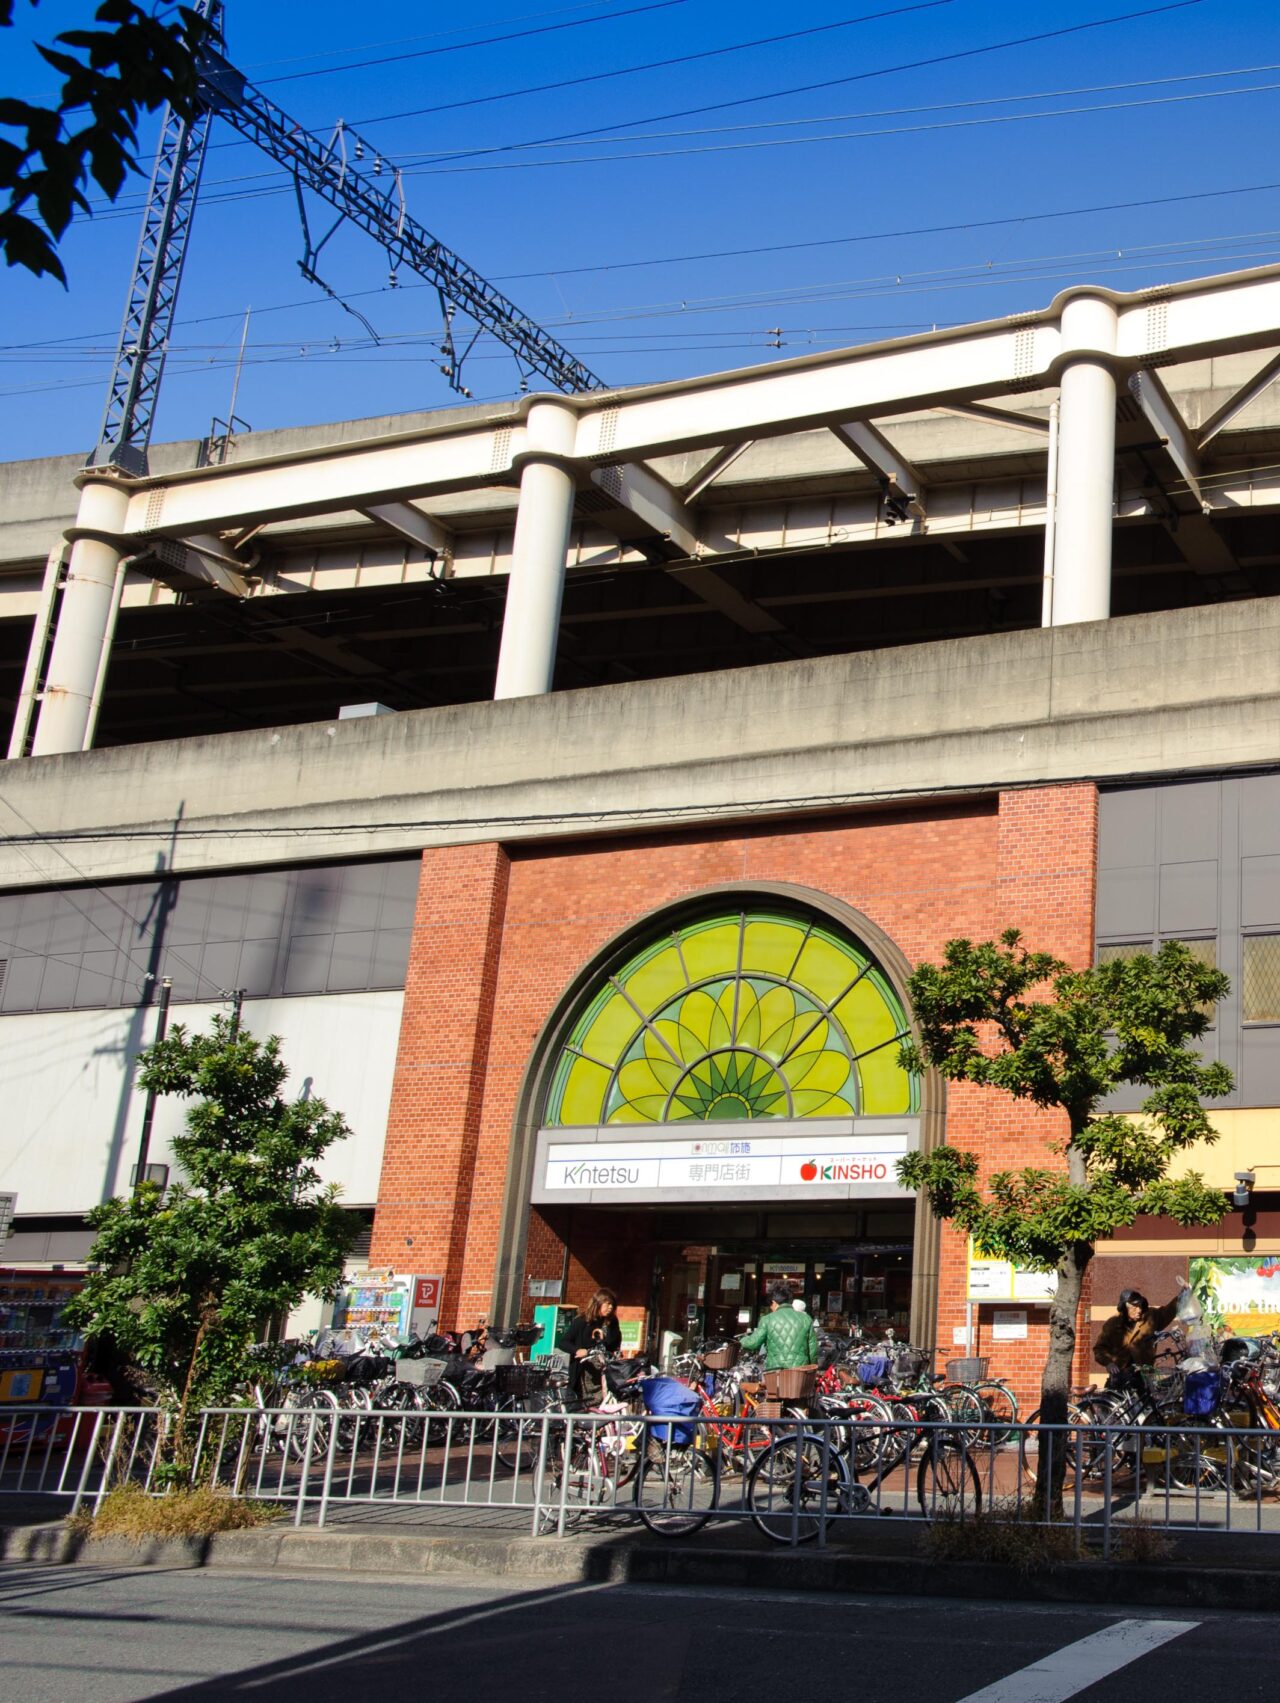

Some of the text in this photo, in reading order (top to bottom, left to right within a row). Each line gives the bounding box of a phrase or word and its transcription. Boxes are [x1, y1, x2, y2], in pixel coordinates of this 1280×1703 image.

[563, 1162, 640, 1184] Kintetsu
[688, 1163, 751, 1181] 専門店街
[820, 1163, 887, 1181] KINSHO
